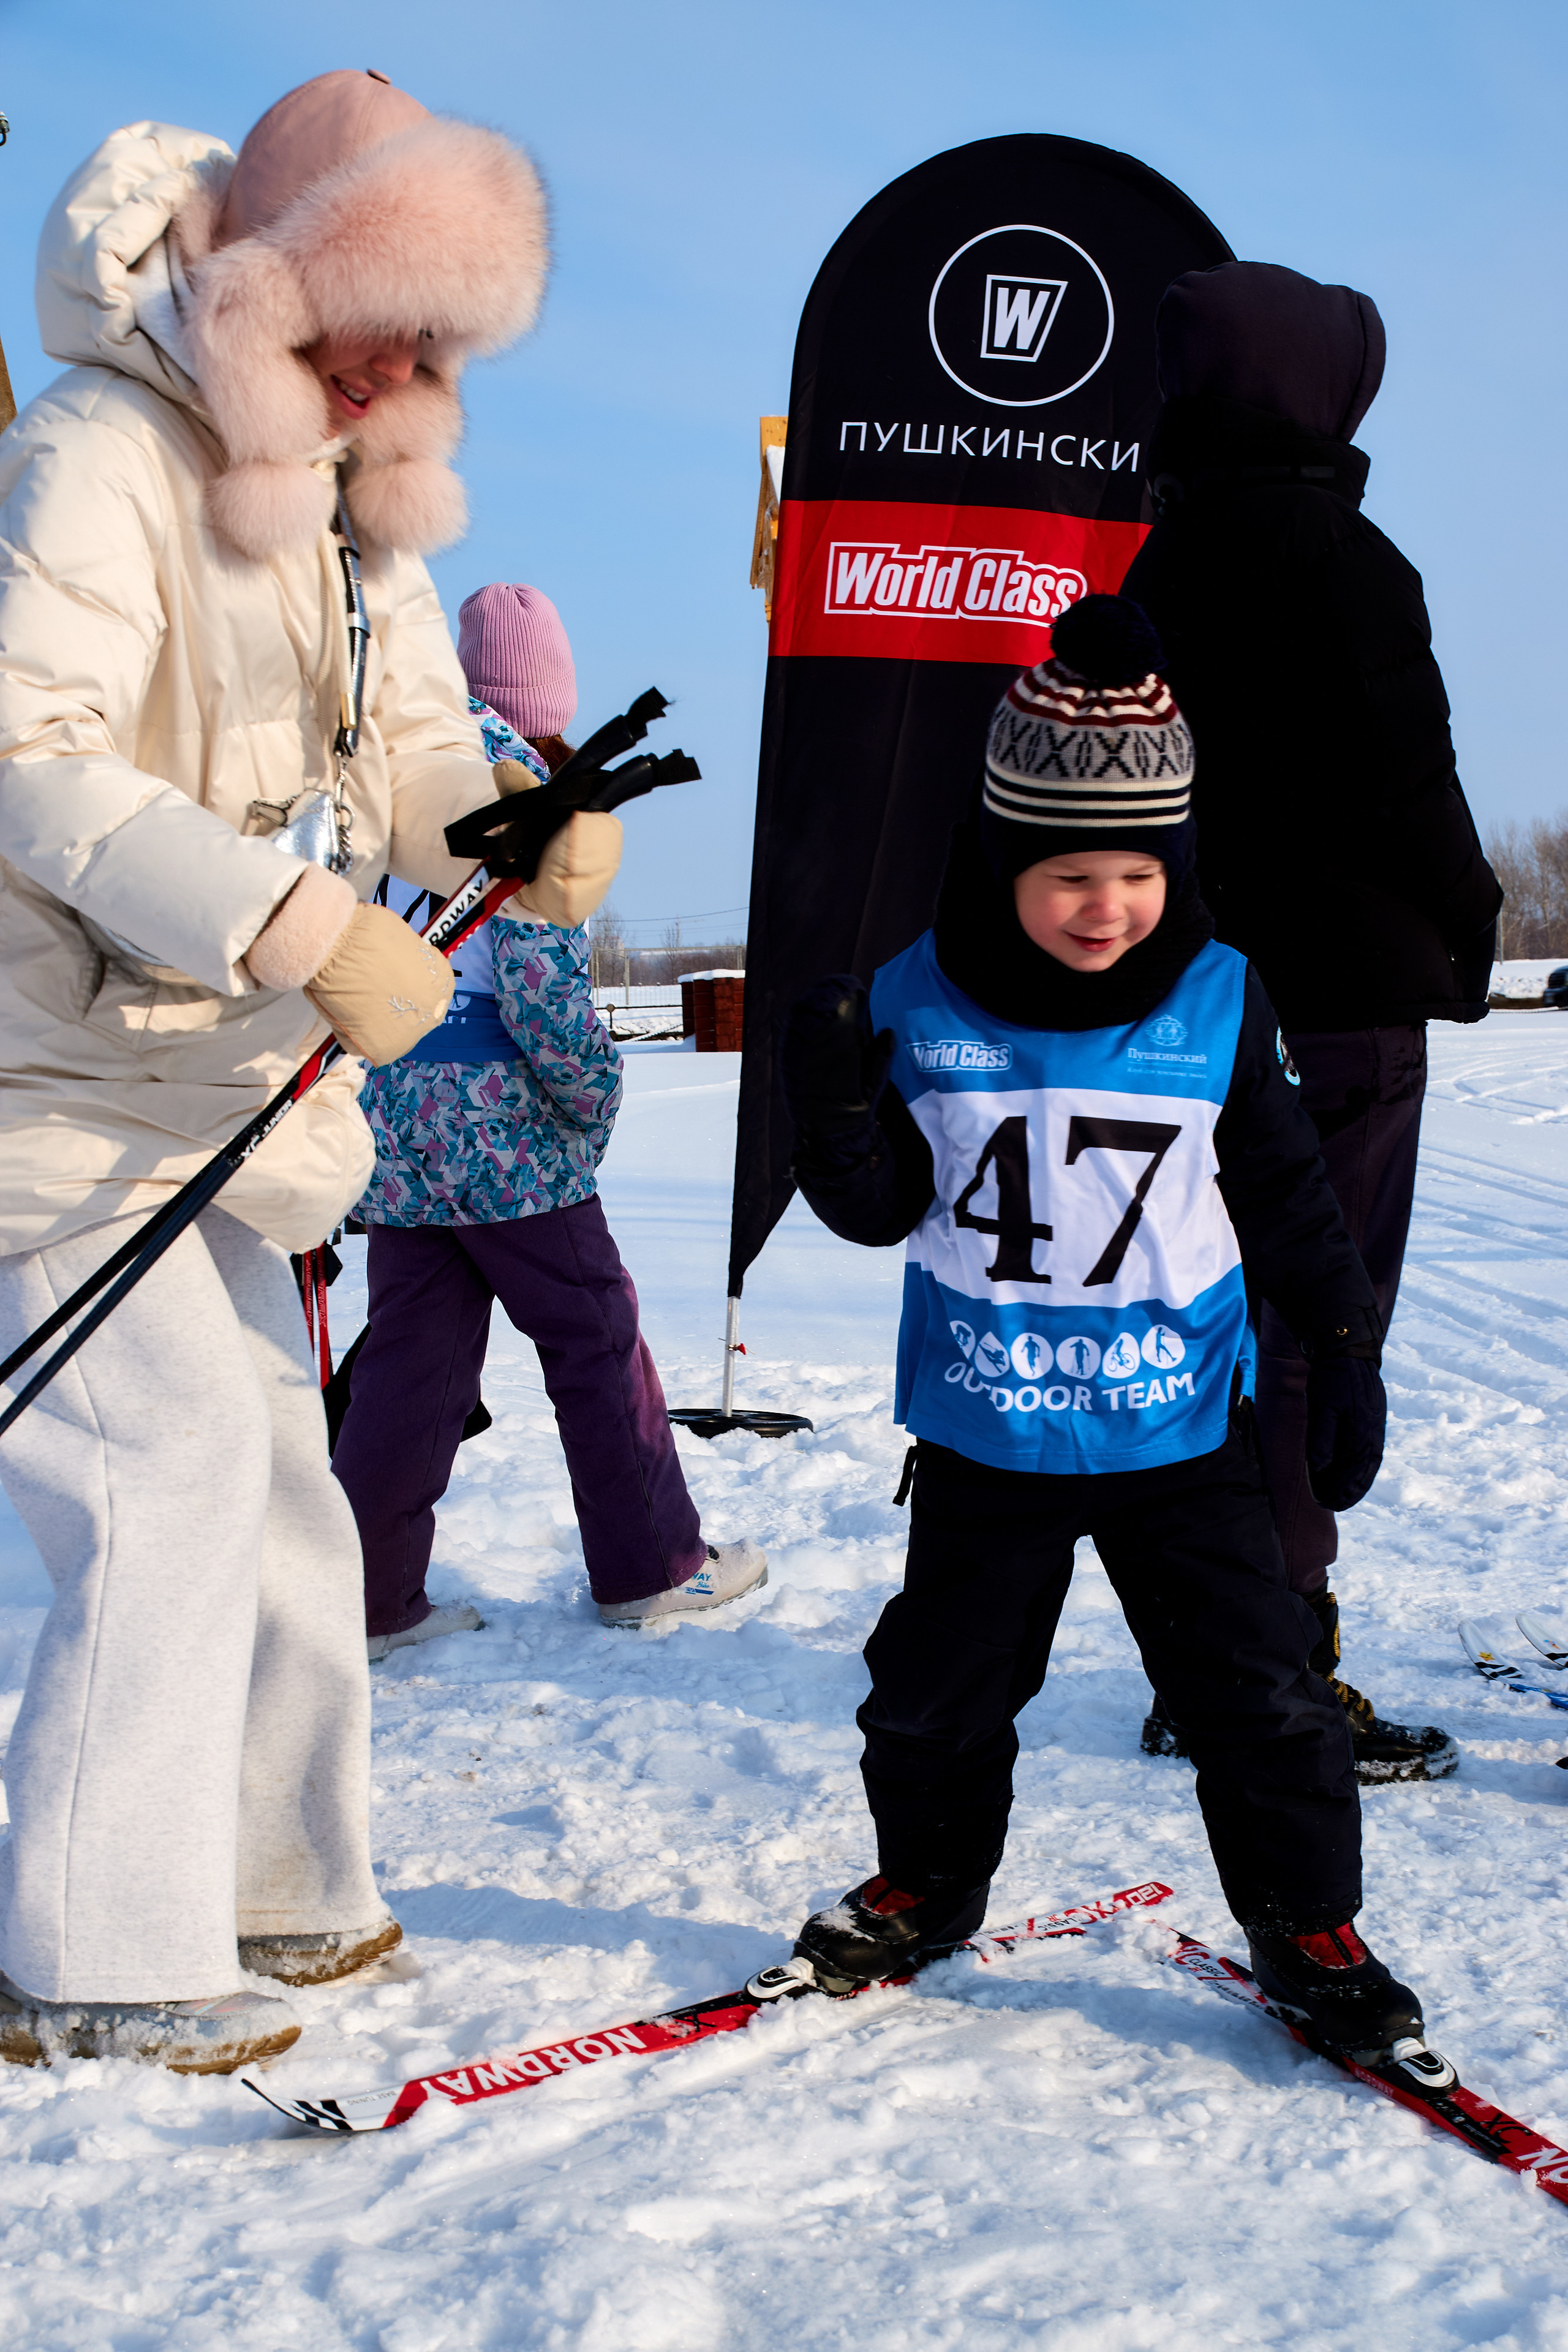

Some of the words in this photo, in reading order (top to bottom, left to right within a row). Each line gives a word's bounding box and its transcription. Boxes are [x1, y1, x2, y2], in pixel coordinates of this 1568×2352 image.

[993, 287, 1050, 350] W
[839, 421, 1140, 472] ПУШКИНСКИ
[835, 552, 965, 609] World
[964, 557, 1078, 619] Class
[428, 879, 483, 945] RDWAY
[959, 1044, 1009, 1068] Class
[262, 1099, 293, 1137] JUNIOR
[953, 1115, 1182, 1287] 47
[1102, 1372, 1195, 1411] TEAM
[1126, 1883, 1164, 1905] 120
[1038, 1917, 1077, 1931] LASSIC
[1188, 1958, 1226, 1977] CLASSIC
[420, 2027, 648, 2100] NORDWAY
